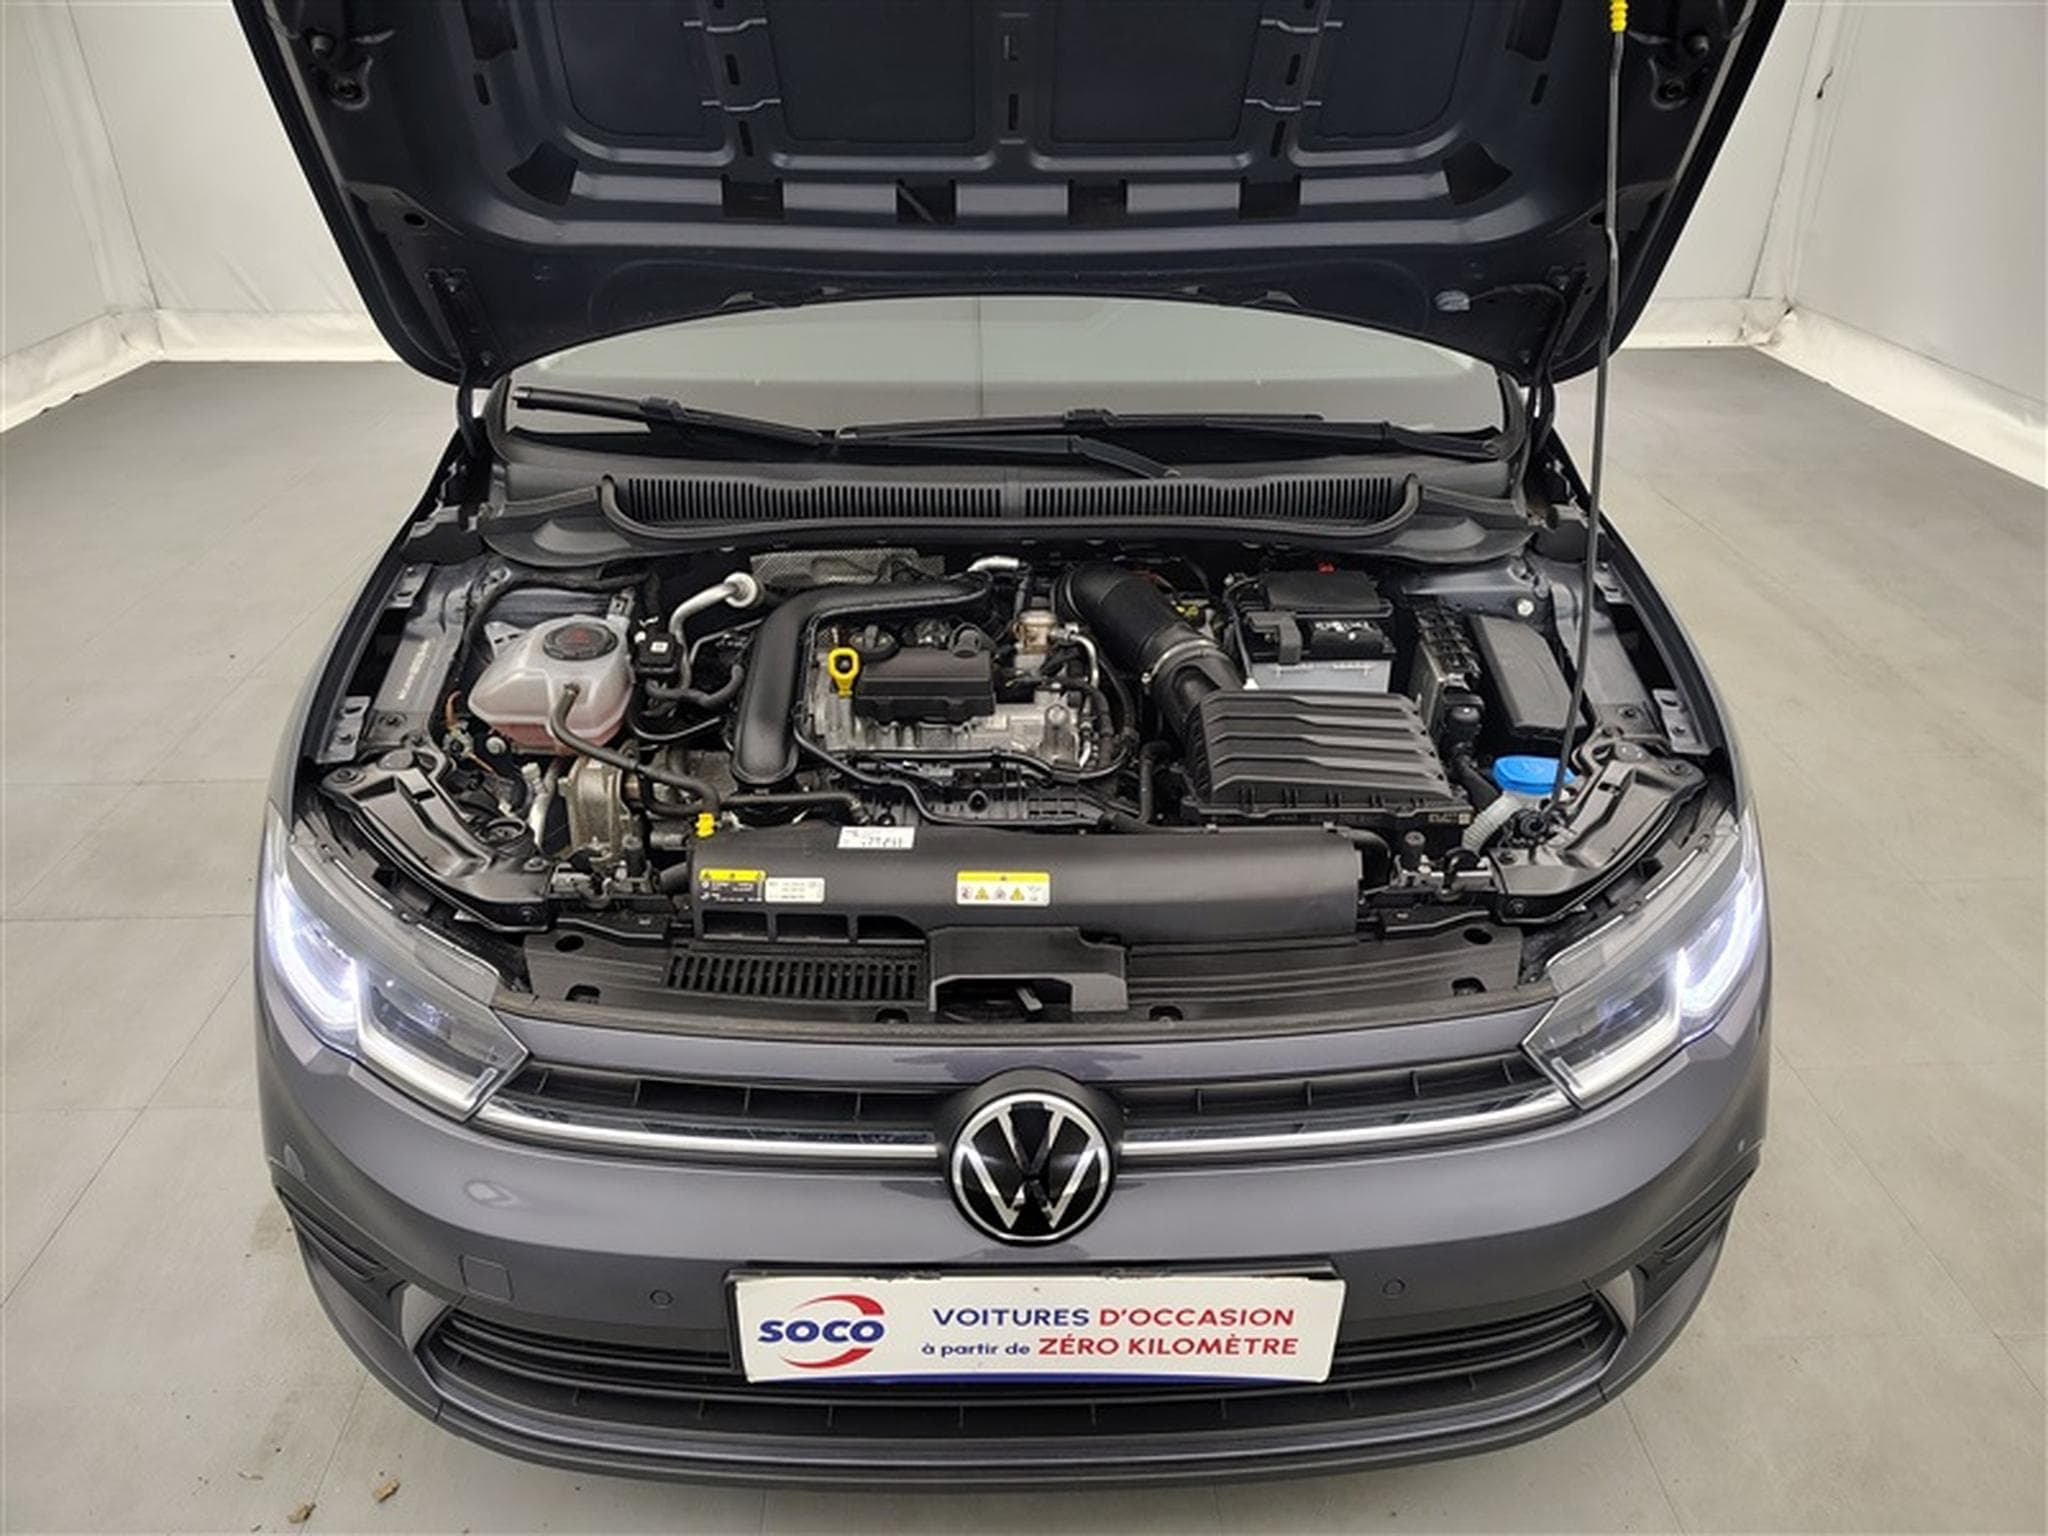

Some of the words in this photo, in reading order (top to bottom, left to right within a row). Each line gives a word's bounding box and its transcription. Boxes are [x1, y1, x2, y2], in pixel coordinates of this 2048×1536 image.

[932, 1308, 1090, 1327] VOITURES
[1099, 1308, 1295, 1327] D'OCCASION
[758, 1319, 885, 1342] SOCO
[921, 1341, 936, 1356] à
[941, 1341, 998, 1358] partir
[1004, 1341, 1031, 1356] de
[1038, 1333, 1119, 1355] ZÉRO
[1127, 1333, 1299, 1355] KILOMÈTRE
